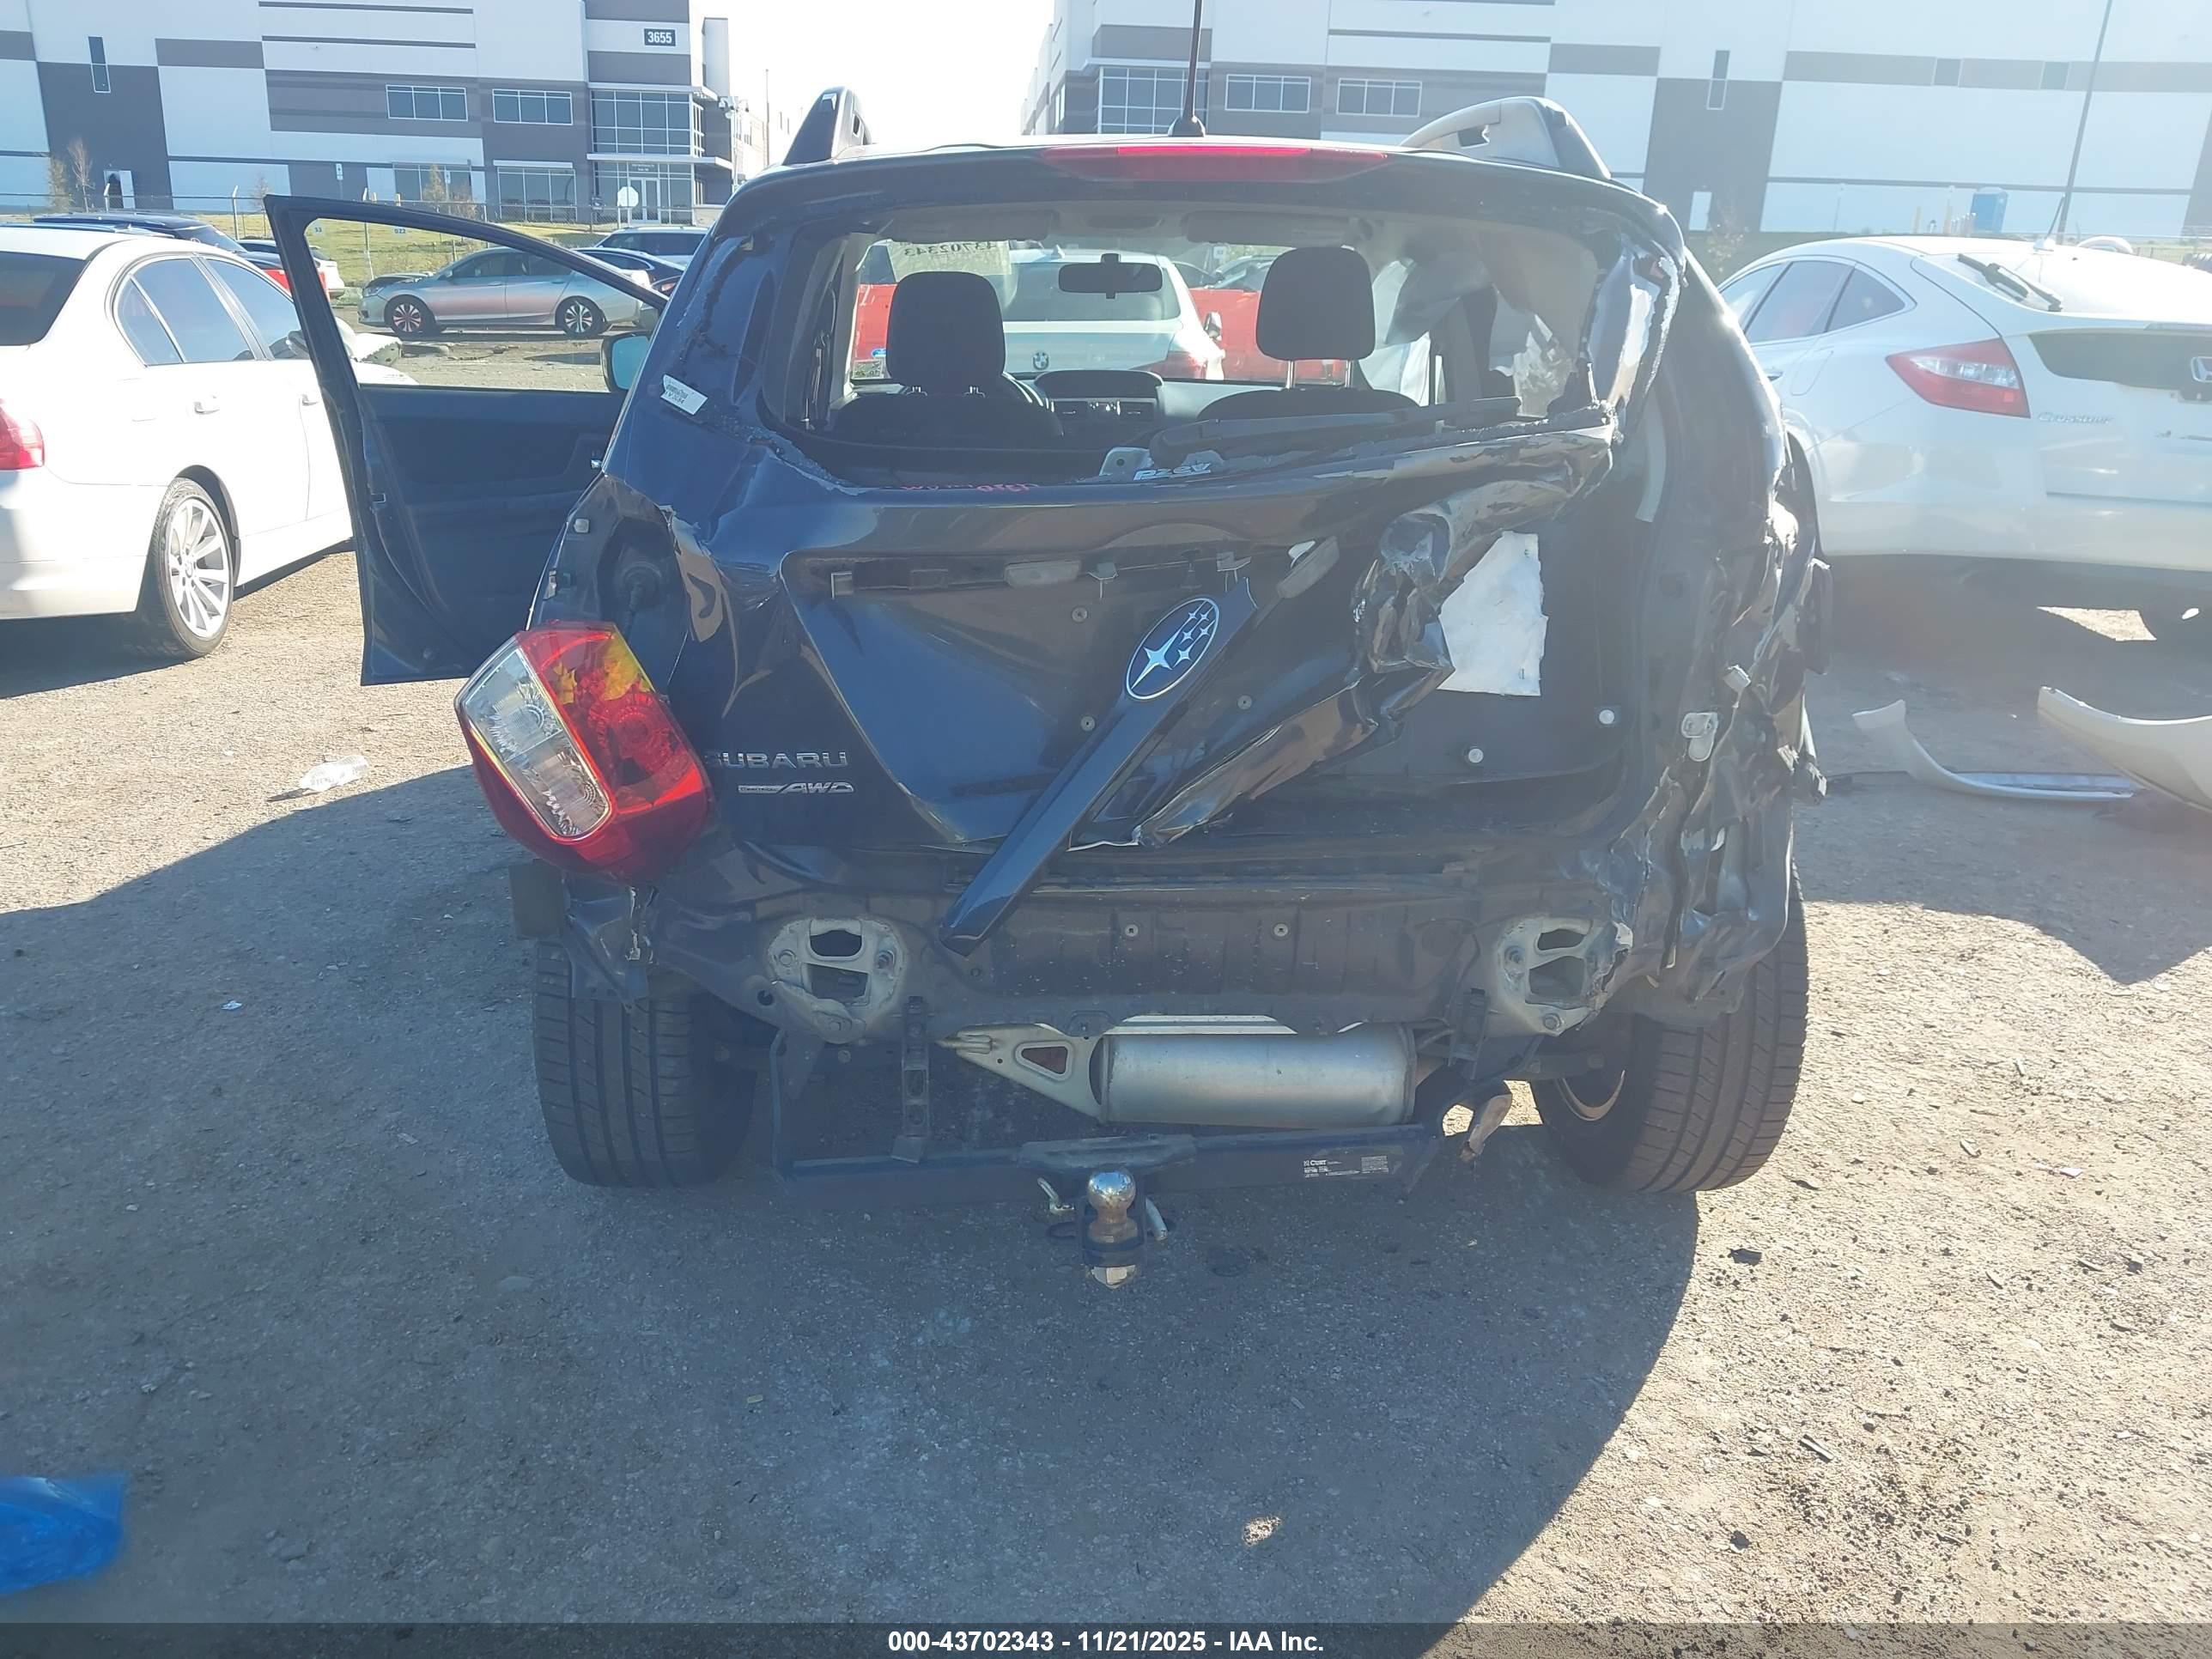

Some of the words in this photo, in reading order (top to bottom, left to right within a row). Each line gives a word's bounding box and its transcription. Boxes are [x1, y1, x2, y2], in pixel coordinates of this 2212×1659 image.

[647, 31, 672, 44] 3655
[704, 751, 848, 769] SUBARU
[781, 782, 854, 794] AWD
